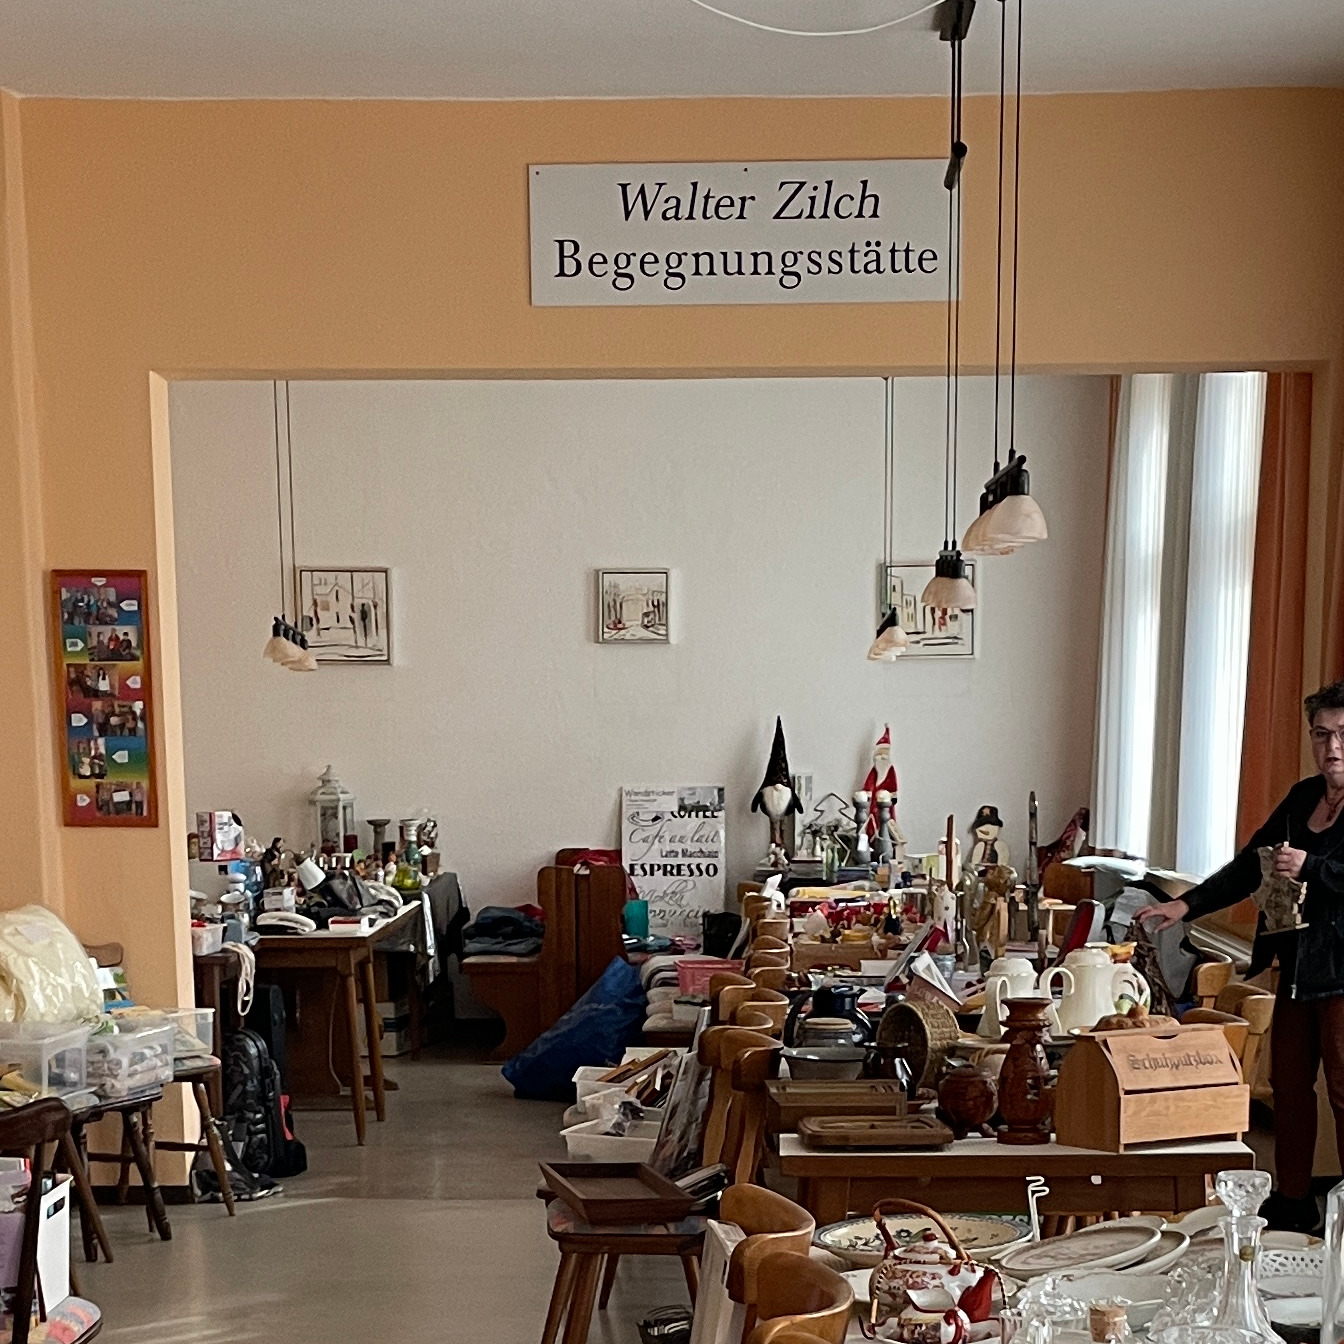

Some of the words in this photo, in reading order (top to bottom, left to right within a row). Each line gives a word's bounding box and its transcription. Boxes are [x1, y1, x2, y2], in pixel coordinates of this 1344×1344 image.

[617, 181, 755, 221] Walter
[772, 179, 882, 220] Zilch
[553, 239, 939, 291] Begegnungsstätte
[628, 862, 720, 878] ESPRESSO
